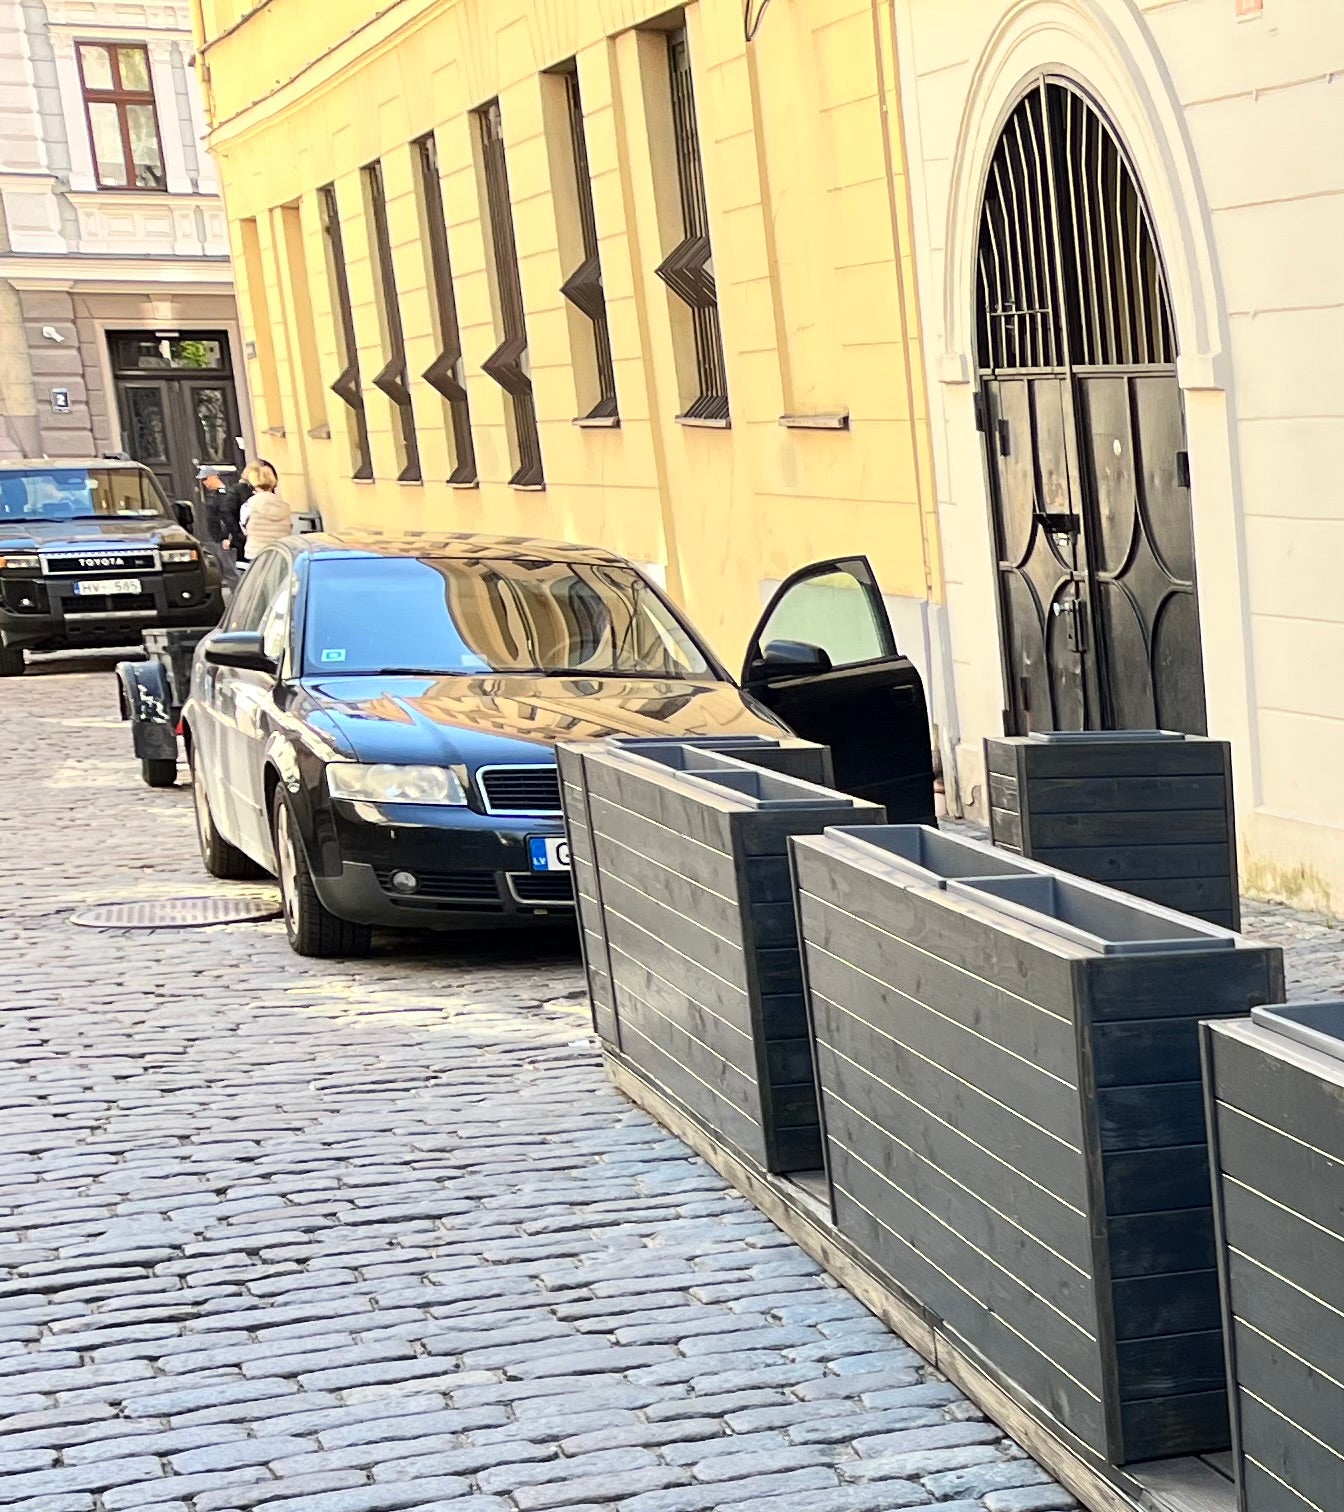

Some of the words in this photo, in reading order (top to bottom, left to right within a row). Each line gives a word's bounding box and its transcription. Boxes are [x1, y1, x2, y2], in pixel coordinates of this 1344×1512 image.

[56, 394, 65, 405] 2
[78, 557, 125, 567] TOYOTA
[533, 857, 547, 866] LV
